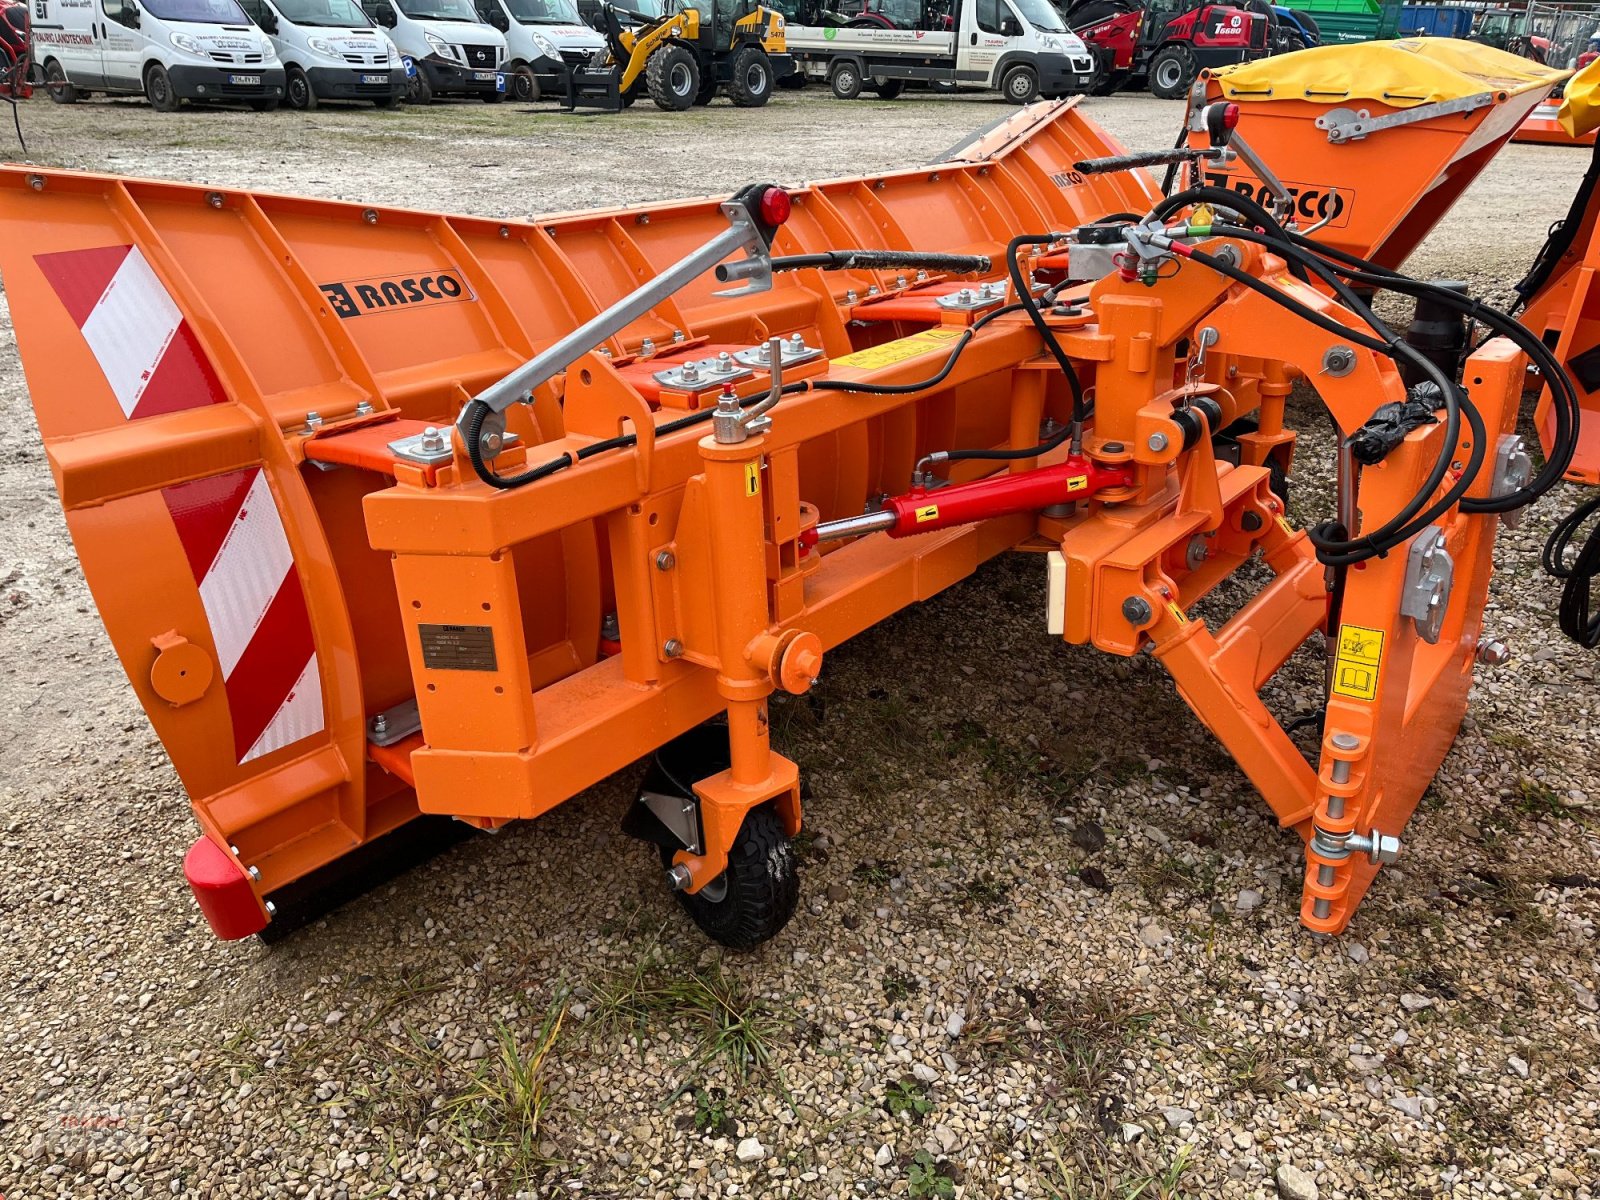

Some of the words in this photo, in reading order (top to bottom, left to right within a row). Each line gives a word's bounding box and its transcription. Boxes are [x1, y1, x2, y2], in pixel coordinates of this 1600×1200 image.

[403, 59, 412, 74] P
[497, 75, 505, 88] P
[354, 275, 461, 308] RASCO
[141, 370, 151, 381] 3M
[238, 508, 248, 521] 3M
[286, 692, 296, 702] 3M
